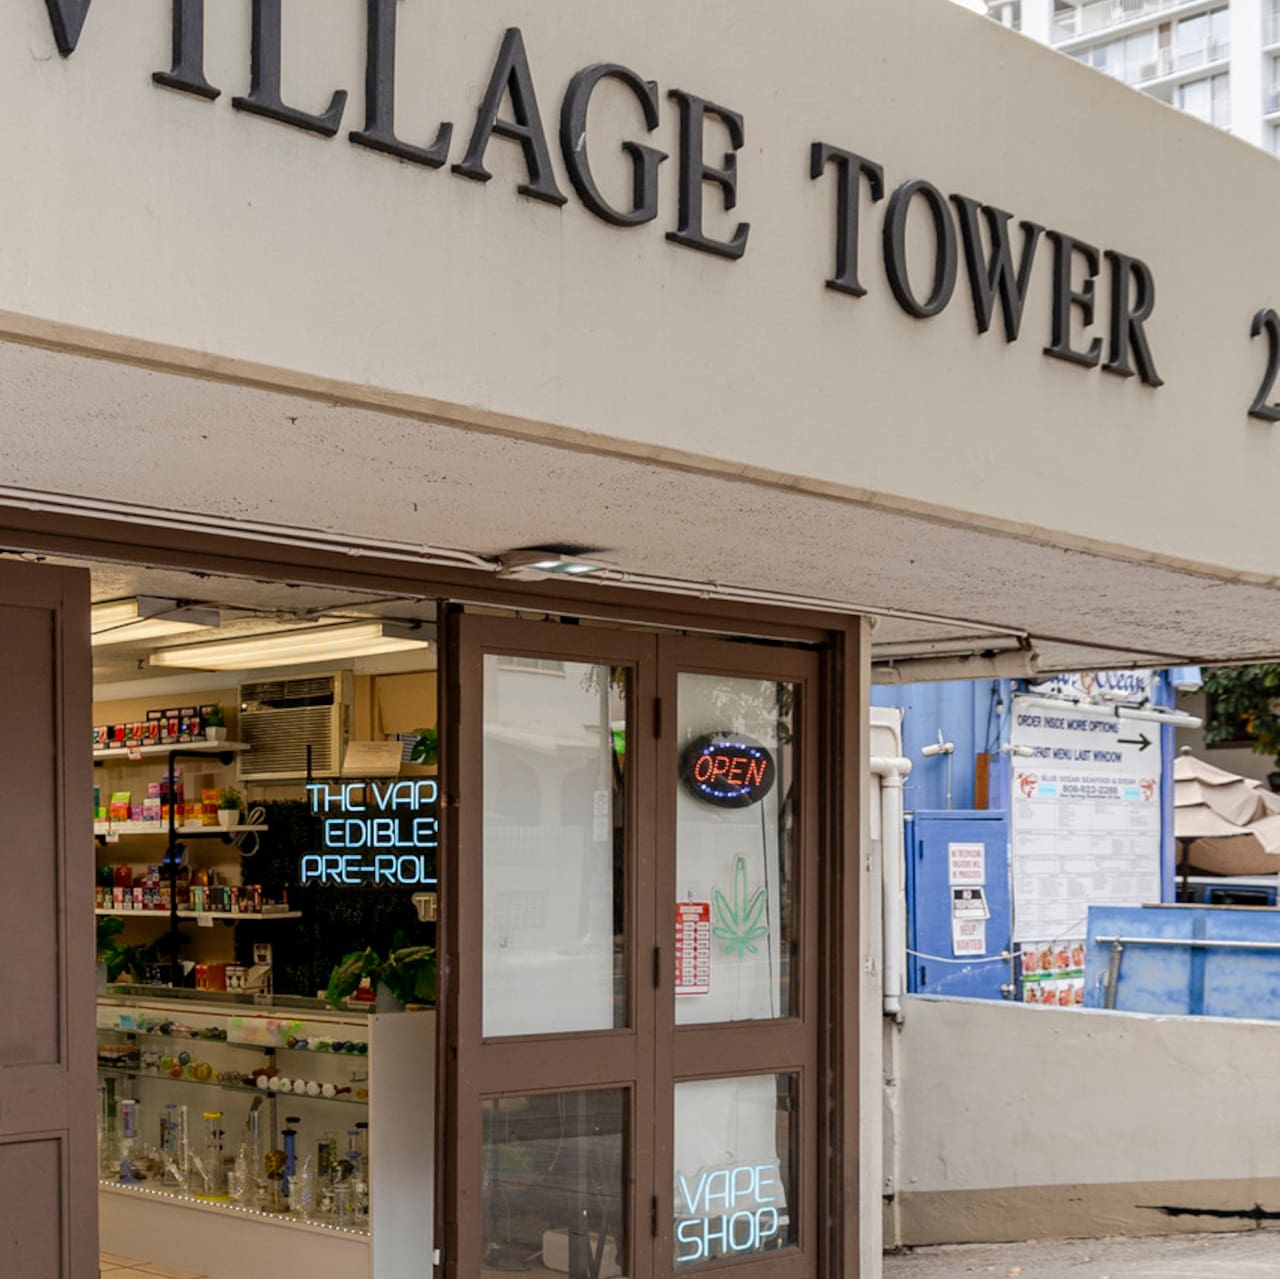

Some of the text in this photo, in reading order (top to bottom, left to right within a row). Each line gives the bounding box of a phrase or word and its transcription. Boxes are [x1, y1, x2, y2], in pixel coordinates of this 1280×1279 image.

[810, 141, 1165, 388] TOWER
[1017, 714, 1119, 734] ORDER INSIDE MORE OPTIONS
[695, 754, 768, 787] OPEN
[1053, 748, 1072, 761] MENU
[1074, 749, 1092, 762] LAST
[1093, 751, 1122, 763] WINDOW
[305, 780, 439, 813] THC VAP
[324, 817, 439, 848] EDIBLE
[301, 854, 439, 884] PRE-ROL
[679, 1164, 777, 1216] VAPE
[676, 1206, 779, 1262] SHOP
